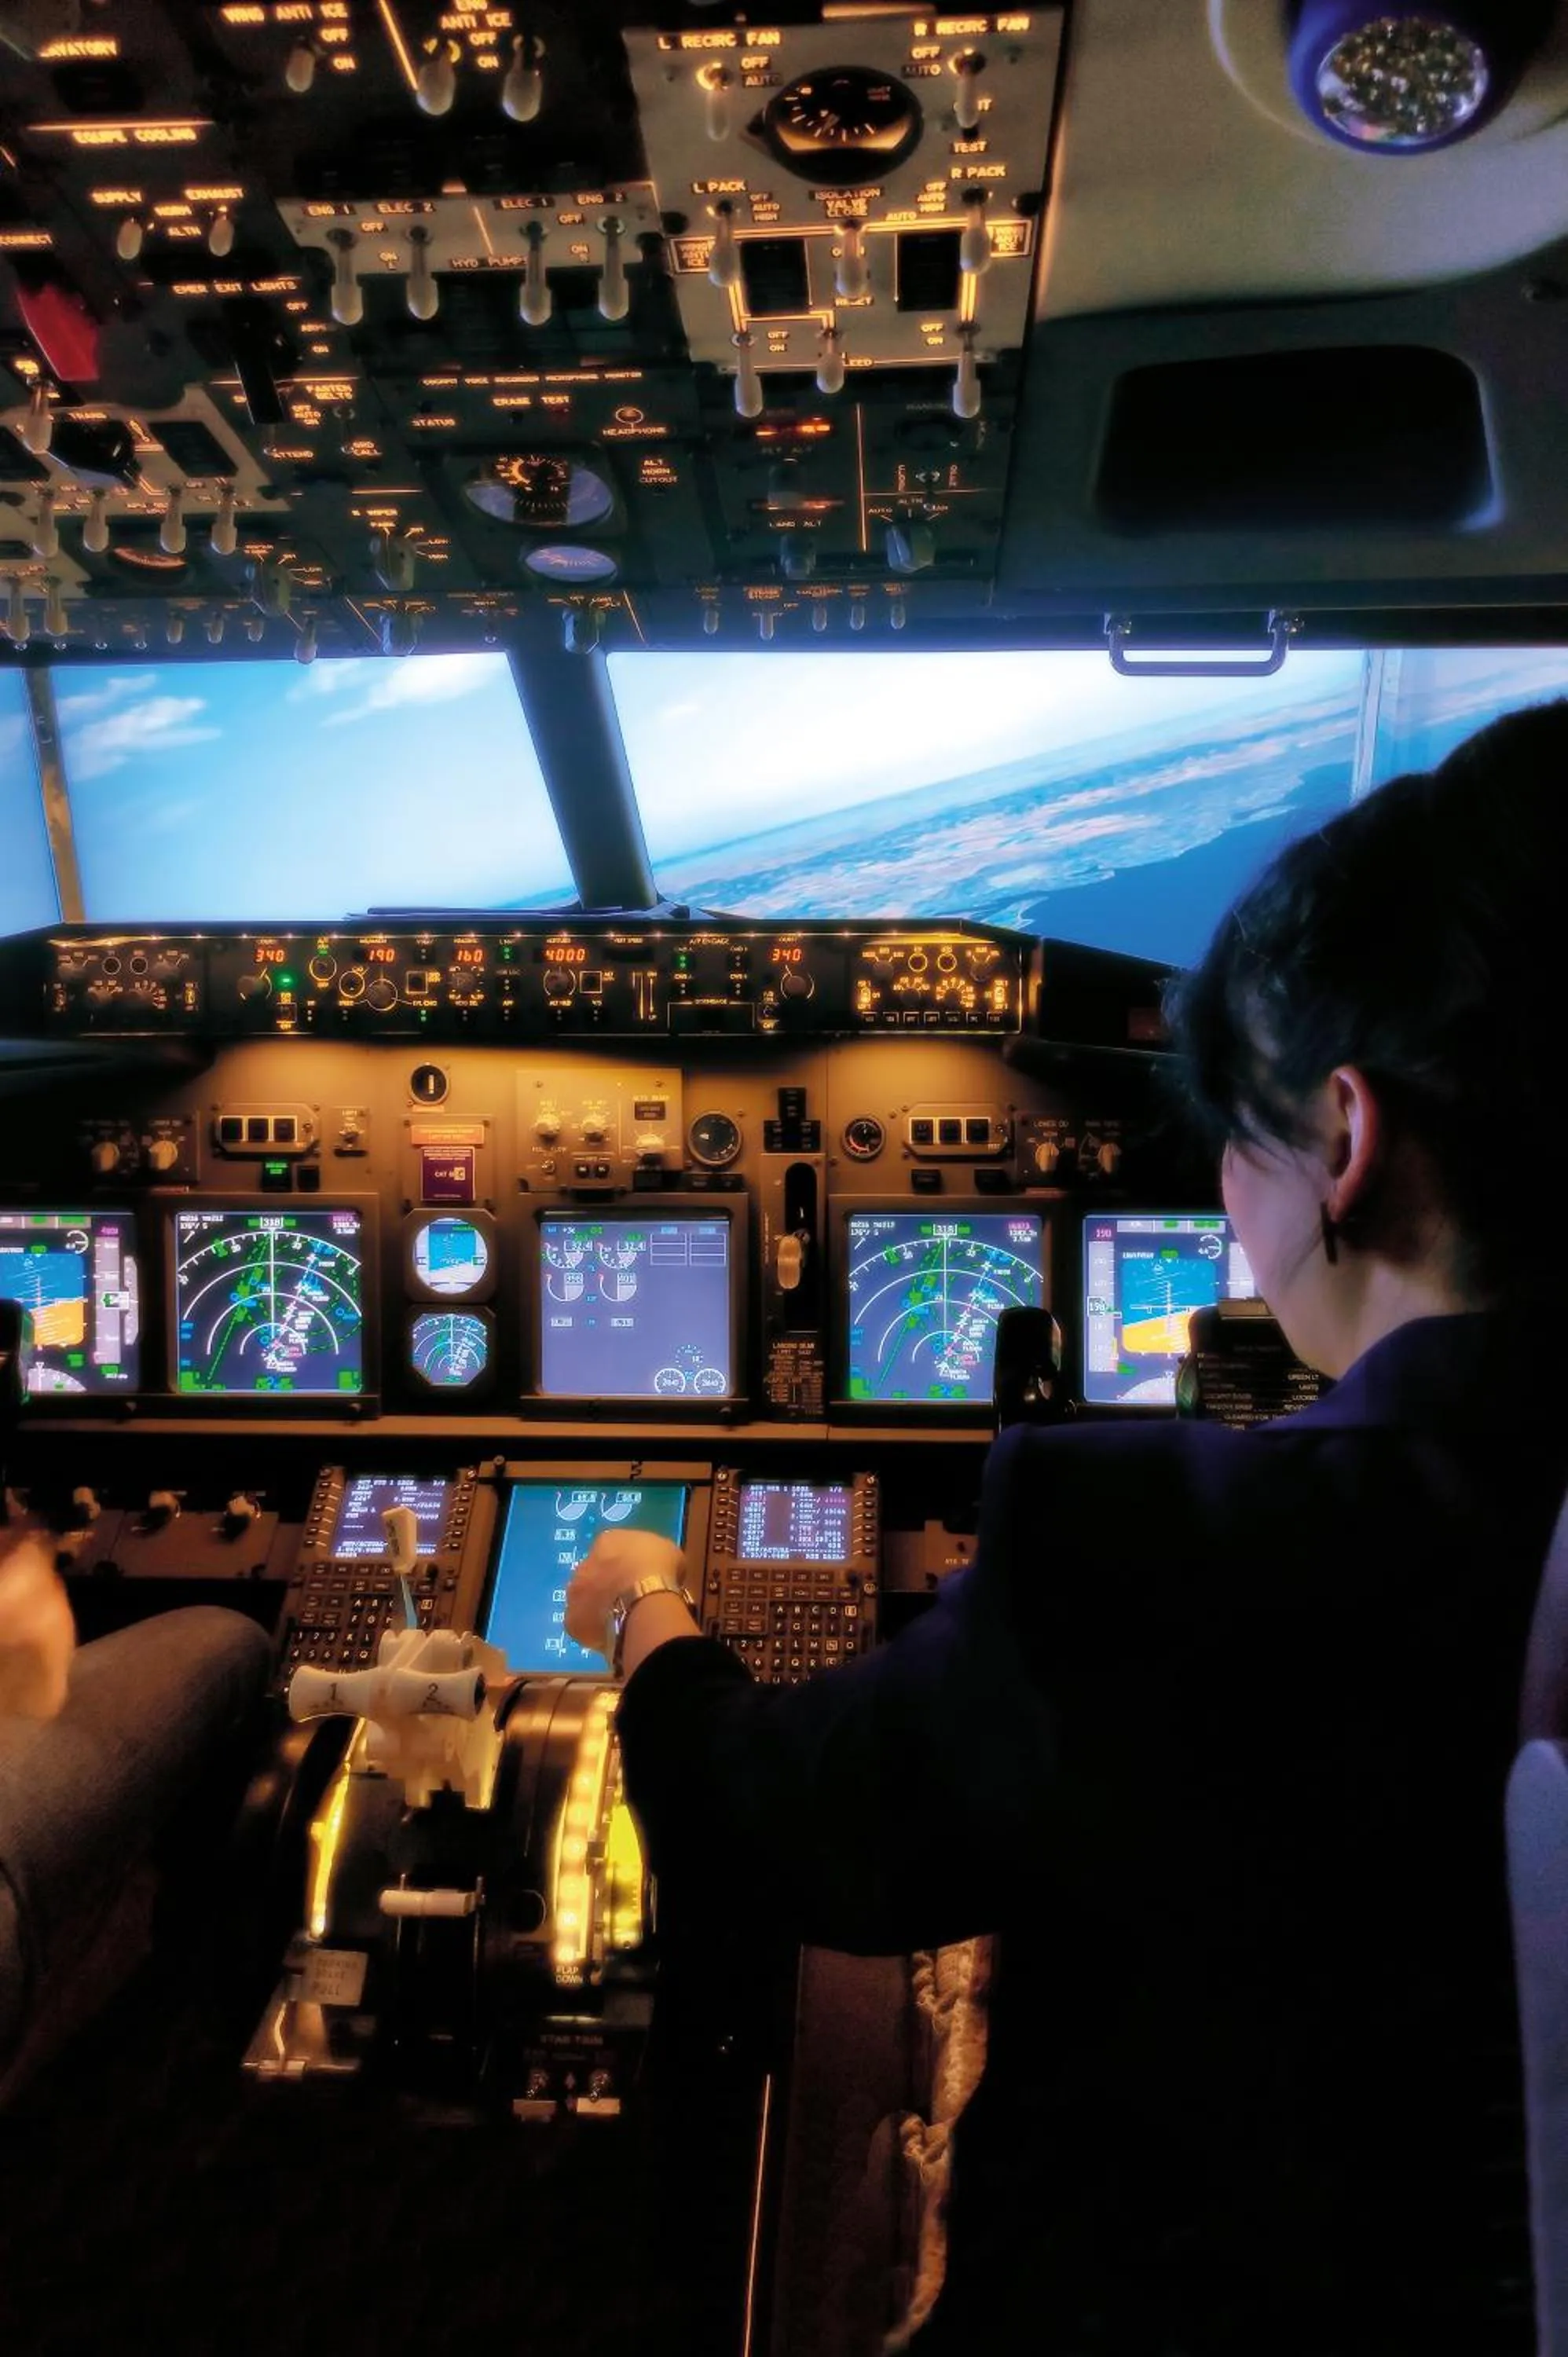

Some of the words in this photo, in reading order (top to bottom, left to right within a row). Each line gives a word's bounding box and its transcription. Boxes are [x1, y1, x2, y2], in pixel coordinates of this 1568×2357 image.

[276, 5, 313, 20] ANTI
[321, 3, 348, 18] ICE
[441, 15, 476, 30] ANTI
[486, 12, 512, 27] ICE
[936, 20, 987, 35] RECIRC
[997, 16, 1029, 32] FAN
[321, 28, 348, 42] OFF
[470, 32, 497, 46] OFF
[658, 38, 672, 49] L
[682, 34, 736, 49] RECIRC
[746, 31, 779, 46] FAN
[911, 46, 940, 60] OFF
[332, 56, 355, 70] ON
[477, 56, 498, 69] ON
[742, 57, 769, 69] OFF
[904, 64, 941, 76] AUTO
[953, 141, 987, 153] TEST
[951, 167, 962, 179] R
[967, 165, 1006, 178] PACK
[693, 183, 704, 194] L
[708, 180, 746, 192] PACK
[925, 181, 947, 191] OFF
[577, 194, 603, 205] ENG
[616, 192, 624, 203] 2
[814, 189, 881, 200] ISOLATION
[918, 193, 946, 202] AUTO
[377, 203, 414, 214] ELEC
[423, 202, 434, 213] 2
[500, 199, 532, 210] ELEC
[542, 197, 548, 207] 1
[753, 203, 780, 211] AUTO
[826, 199, 867, 210] VALVE
[307, 206, 335, 216] ENG
[344, 205, 350, 215] 1
[885, 212, 917, 221] AUTO
[559, 214, 582, 224] OFF
[361, 222, 384, 233] OFF
[570, 244, 588, 254] ON
[379, 252, 397, 262] ON
[452, 258, 478, 268] HYD
[921, 324, 943, 332] OFF
[927, 337, 943, 346] ON
[843, 358, 873, 367] LEED
[493, 397, 532, 406] ERASE
[603, 427, 667, 437] HEADPHONE
[255, 949, 284, 962] 340
[369, 949, 394, 962] 190
[546, 948, 585, 961] 4000
[771, 948, 802, 961] 340
[264, 1218, 280, 1226] 318
[936, 1225, 954, 1233] 318
[793, 1622, 800, 1631] G
[329, 1682, 337, 1700] 1
[427, 1682, 439, 1701] 2
[555, 1966, 579, 1975] FLAP
[555, 1974, 584, 1984] DOWN
